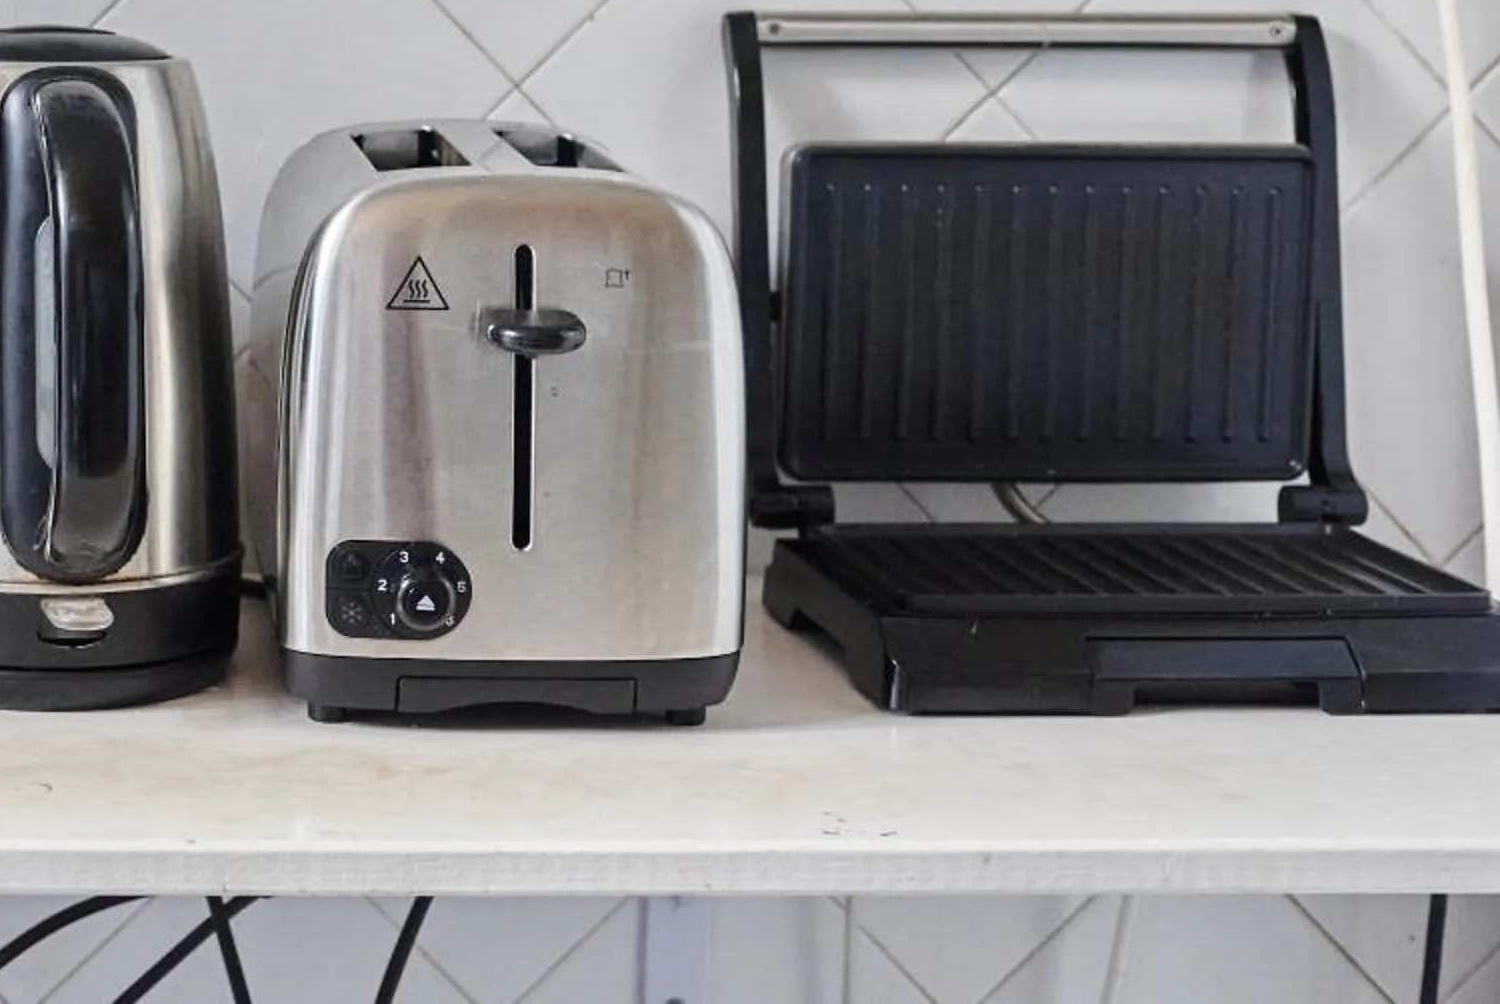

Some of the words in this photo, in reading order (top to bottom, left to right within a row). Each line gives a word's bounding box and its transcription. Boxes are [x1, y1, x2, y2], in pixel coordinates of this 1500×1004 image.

[400, 551, 409, 563] 3
[435, 552, 445, 564] 4
[378, 579, 388, 591] 2
[457, 581, 466, 593] 5
[390, 612, 396, 625] 1
